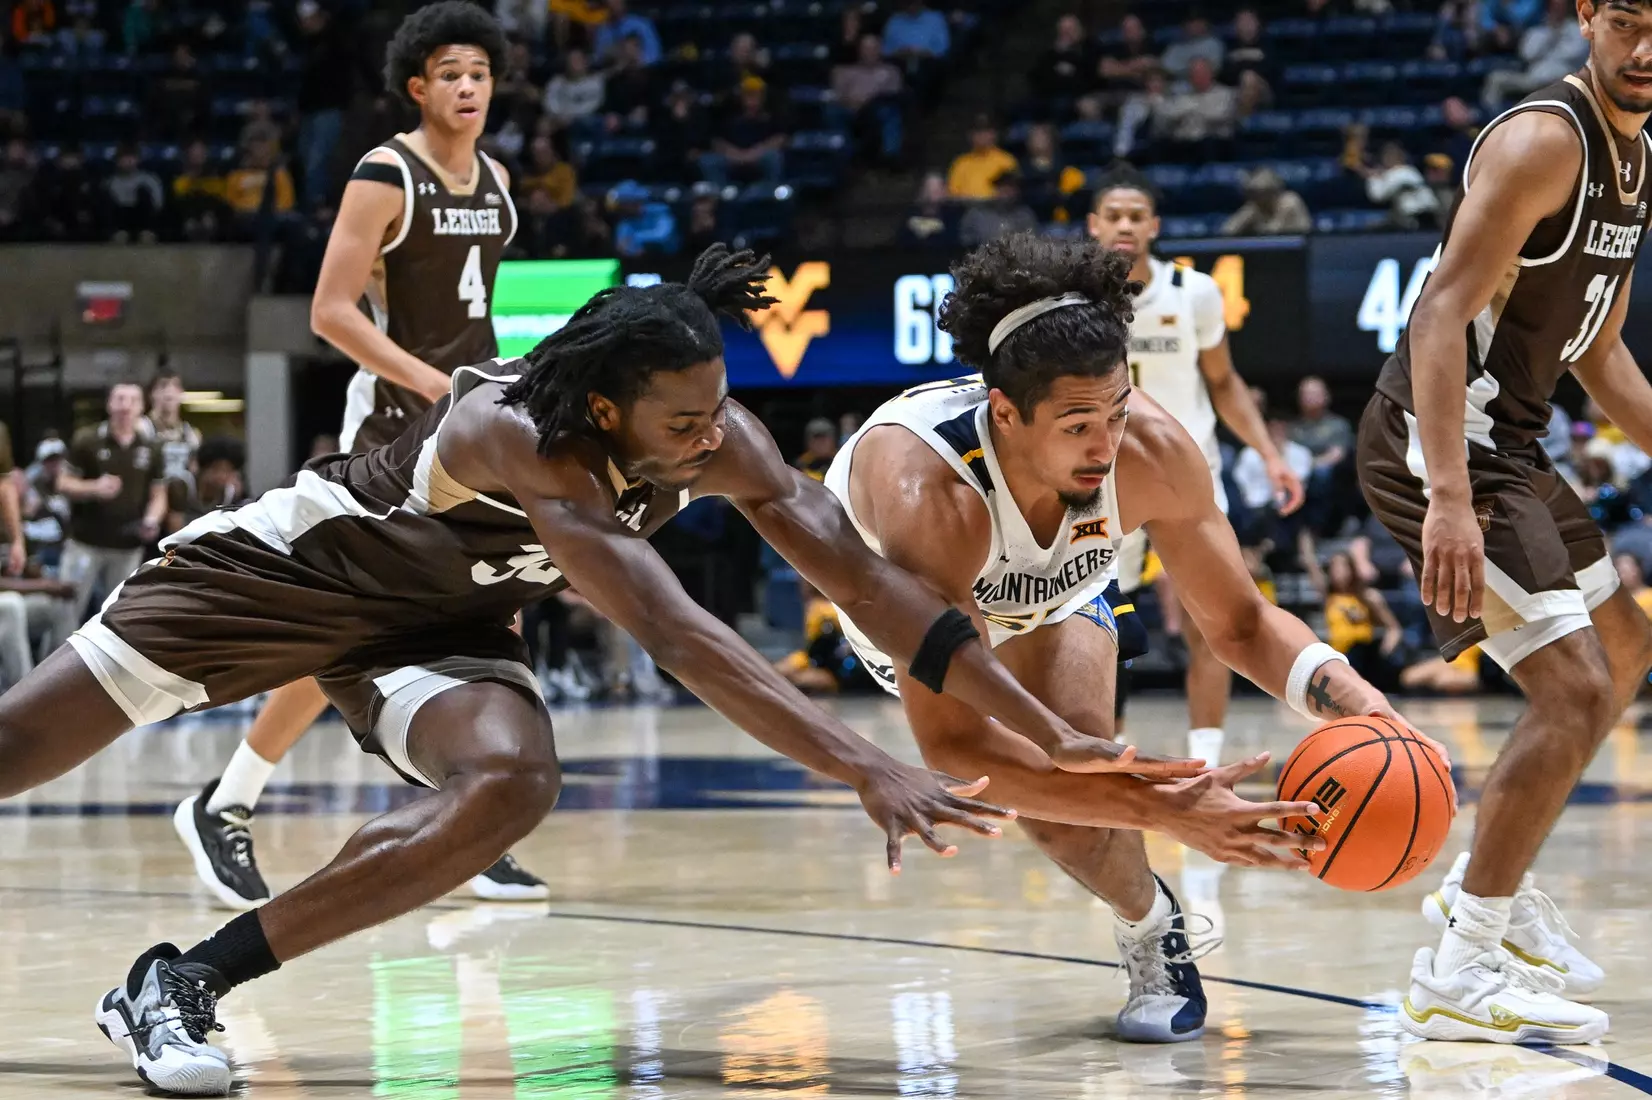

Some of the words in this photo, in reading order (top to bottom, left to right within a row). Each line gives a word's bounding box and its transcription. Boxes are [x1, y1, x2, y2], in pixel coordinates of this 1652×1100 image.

[431, 208, 502, 235] LEHIGH
[457, 245, 487, 319] 4
[1560, 274, 1619, 362] 31
